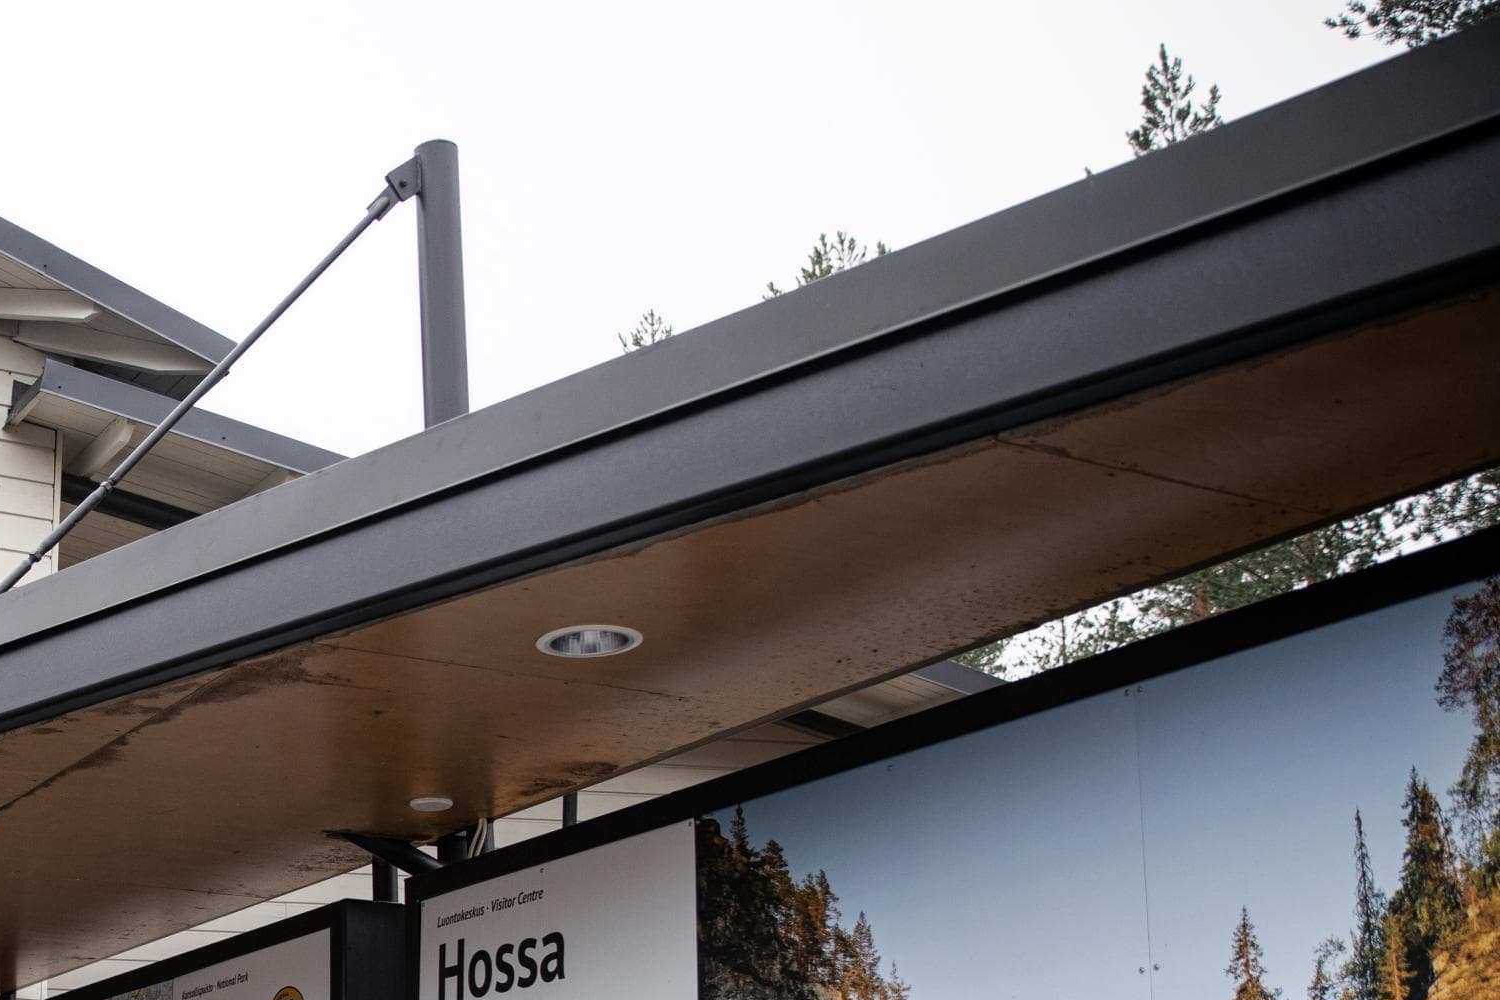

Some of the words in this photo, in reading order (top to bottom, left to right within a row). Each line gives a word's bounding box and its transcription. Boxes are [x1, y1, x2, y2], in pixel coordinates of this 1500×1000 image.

[437, 905, 485, 929] Luontokeskus
[491, 897, 515, 913] Visitor
[517, 889, 544, 906] Centre
[216, 976, 236, 992] National
[237, 971, 248, 984] Park
